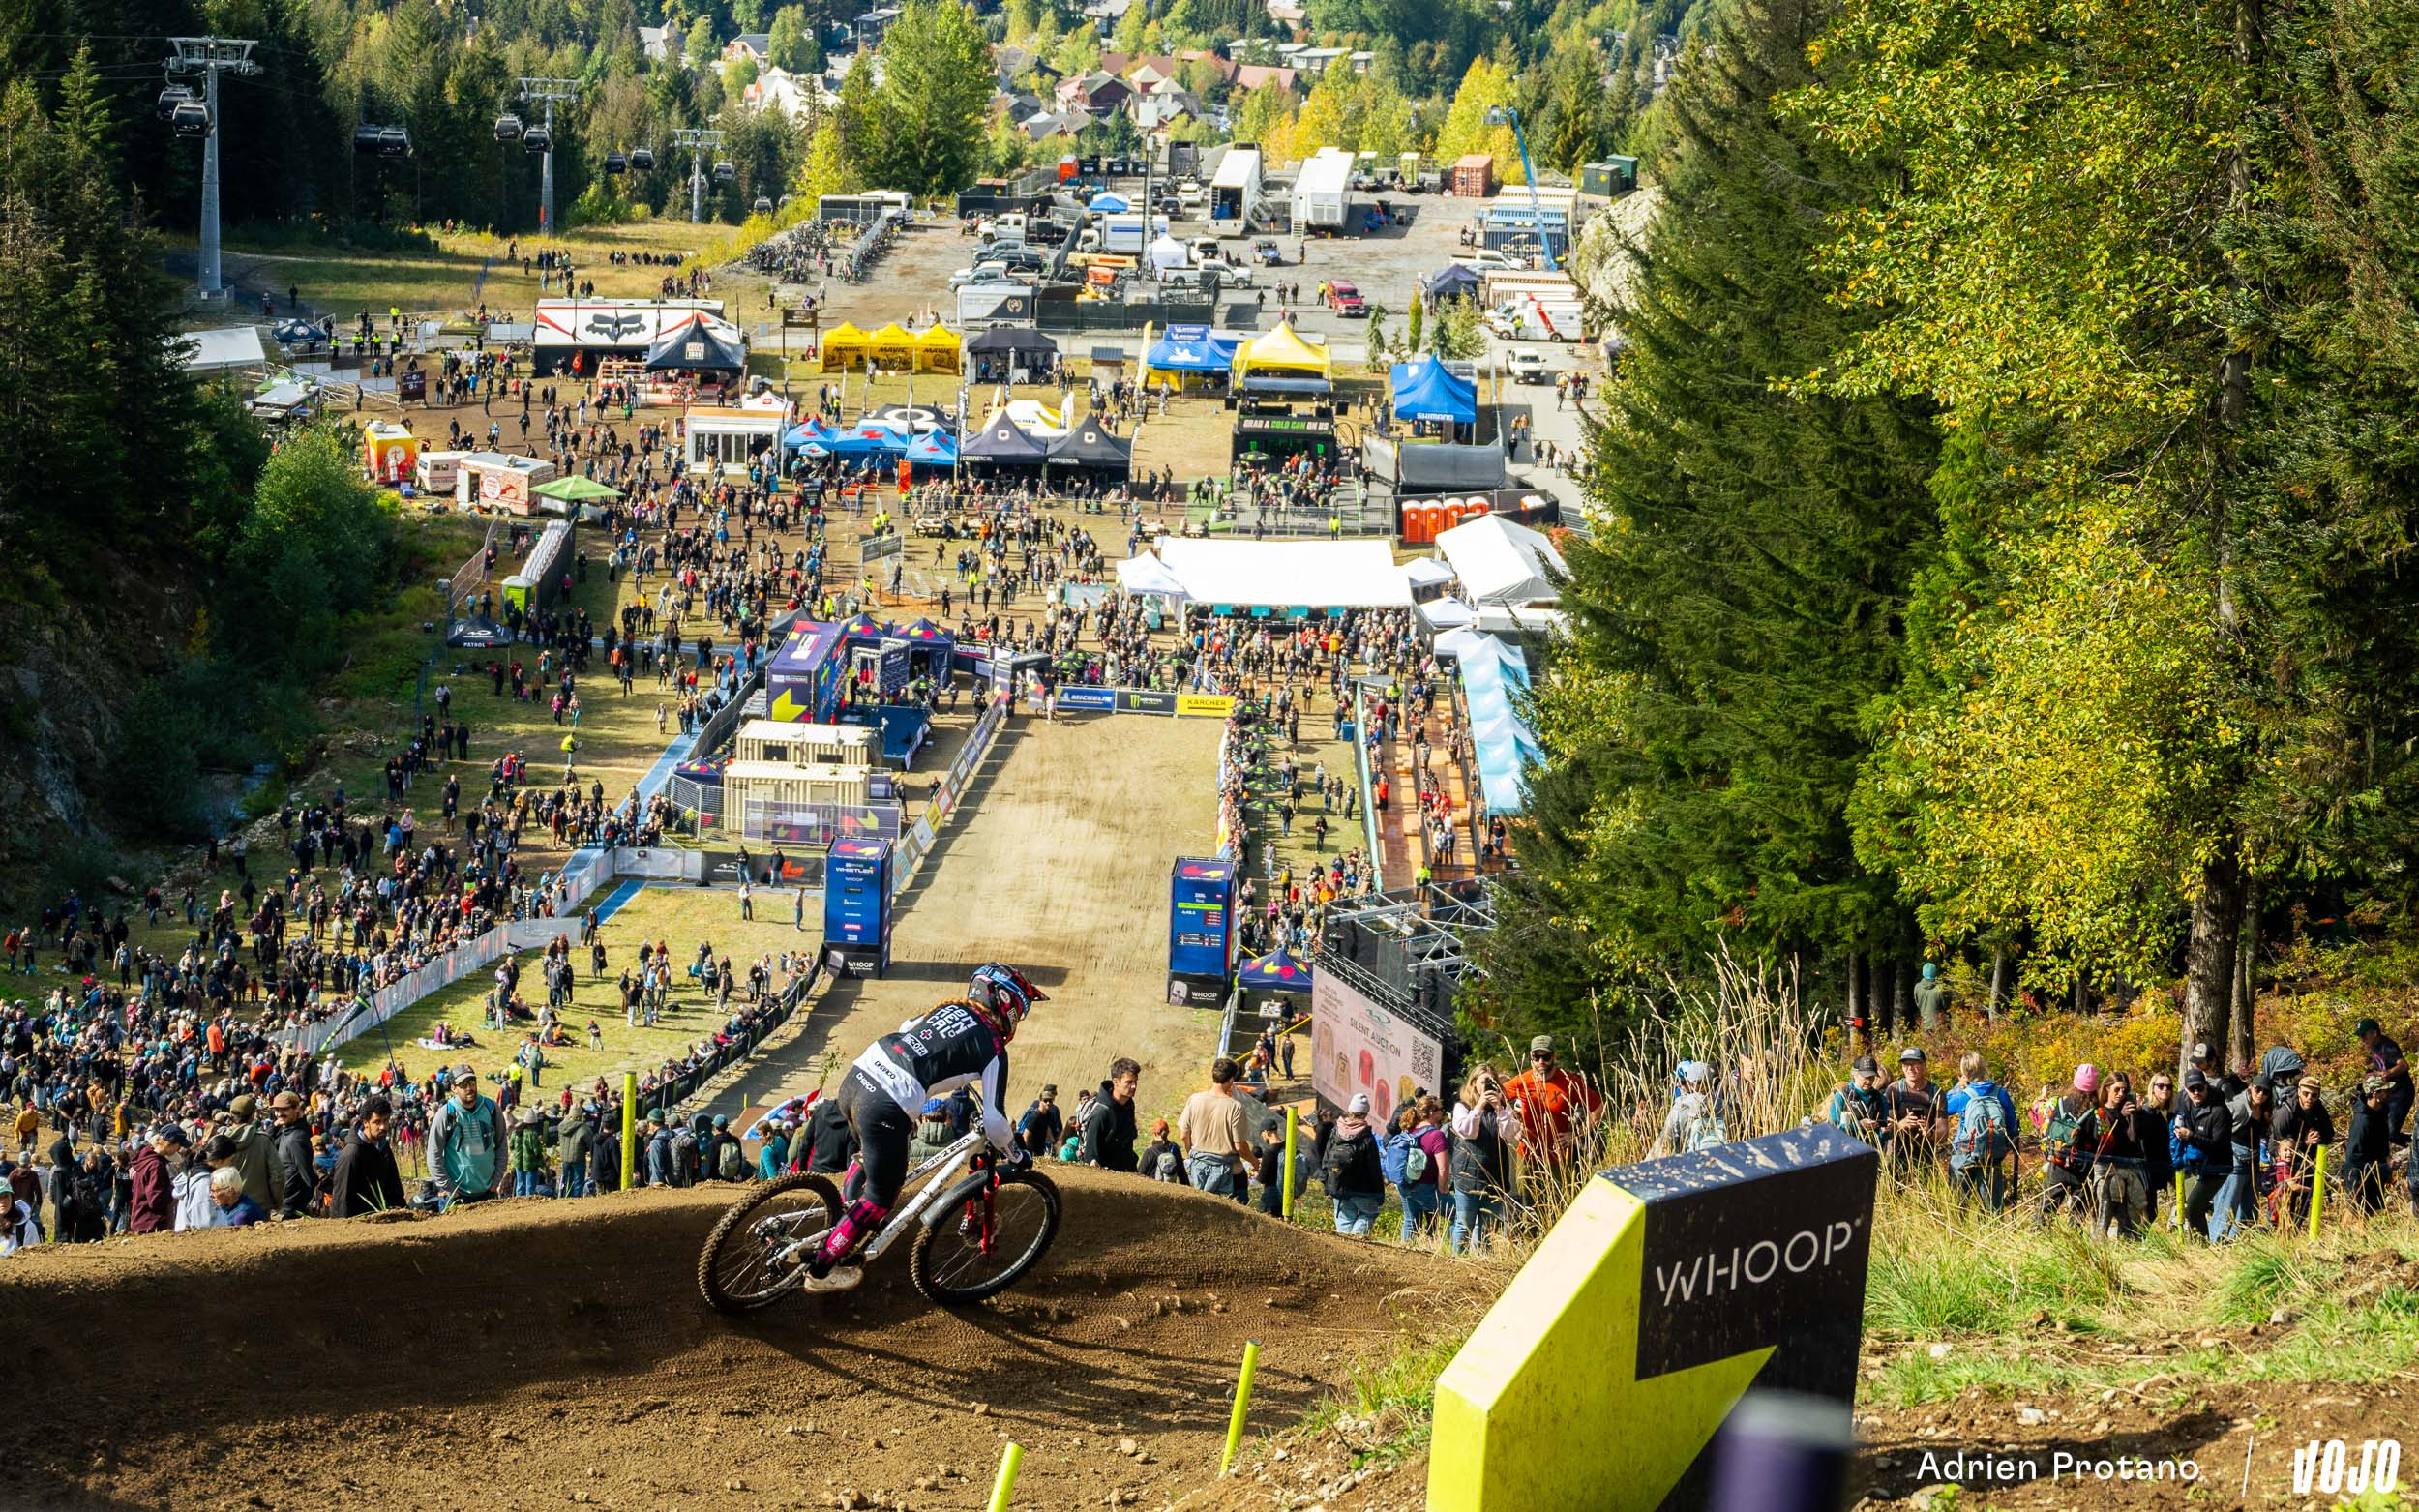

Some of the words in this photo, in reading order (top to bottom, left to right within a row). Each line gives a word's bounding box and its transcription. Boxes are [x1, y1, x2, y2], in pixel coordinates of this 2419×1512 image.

[1242, 419, 1263, 429] GRAB
[1264, 420, 1270, 429] A
[1270, 420, 1290, 430] COLD
[1291, 421, 1306, 430] CAN
[1306, 421, 1317, 430] ON
[1318, 422, 1329, 430] US
[1417, 412, 1454, 421] SHIMANO
[1349, 1017, 1370, 1038] SILENT
[1370, 1031, 1401, 1057] AUCTION
[1656, 1221, 1853, 1307] WHOOP
